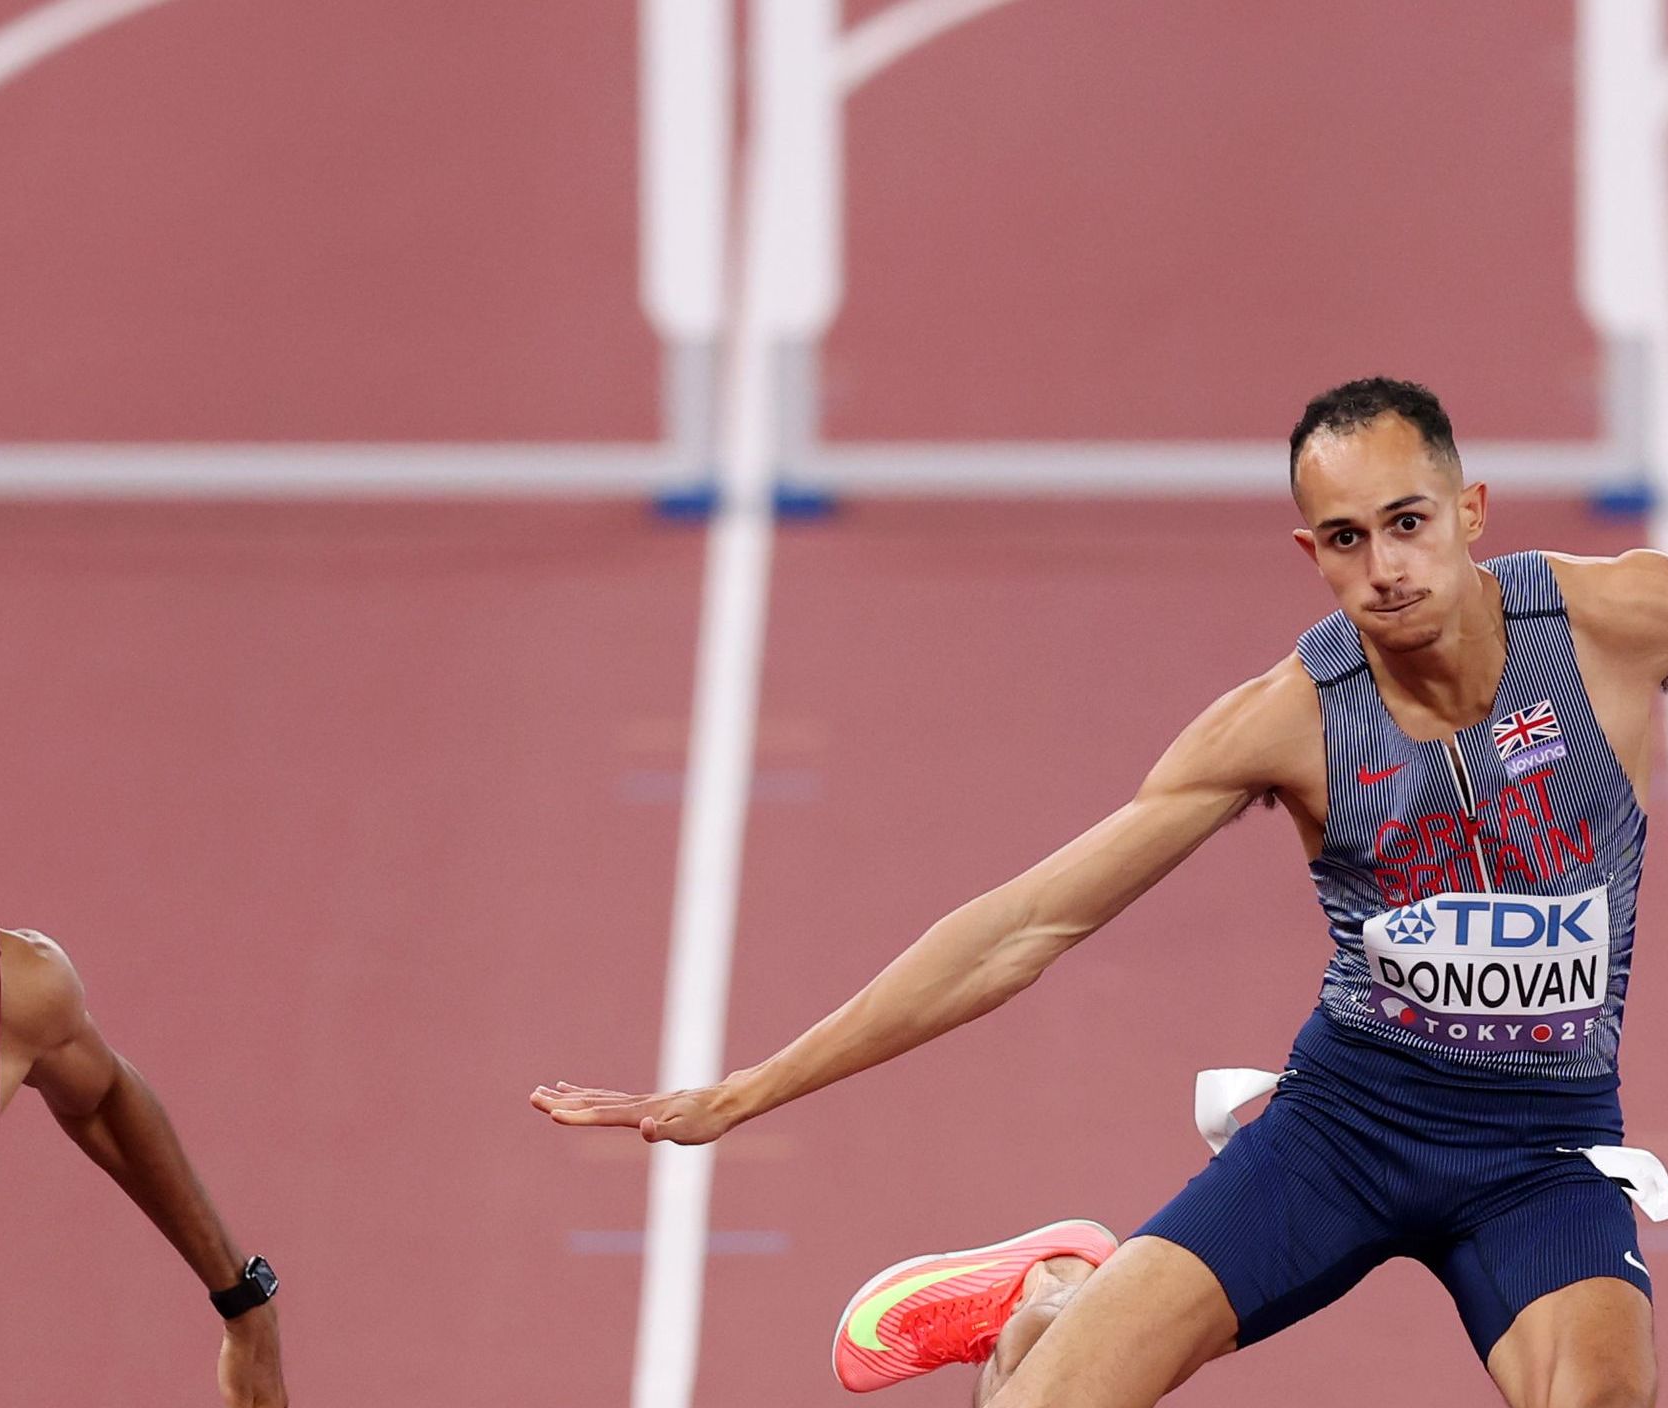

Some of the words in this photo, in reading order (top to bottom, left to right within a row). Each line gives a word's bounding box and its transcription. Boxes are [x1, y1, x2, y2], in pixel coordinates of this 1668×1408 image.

[1374, 768, 1556, 865] GREAT
[1373, 818, 1595, 908] BRITAIN
[1436, 898, 1594, 948] TDK
[1379, 954, 1598, 1009] DONOVAN
